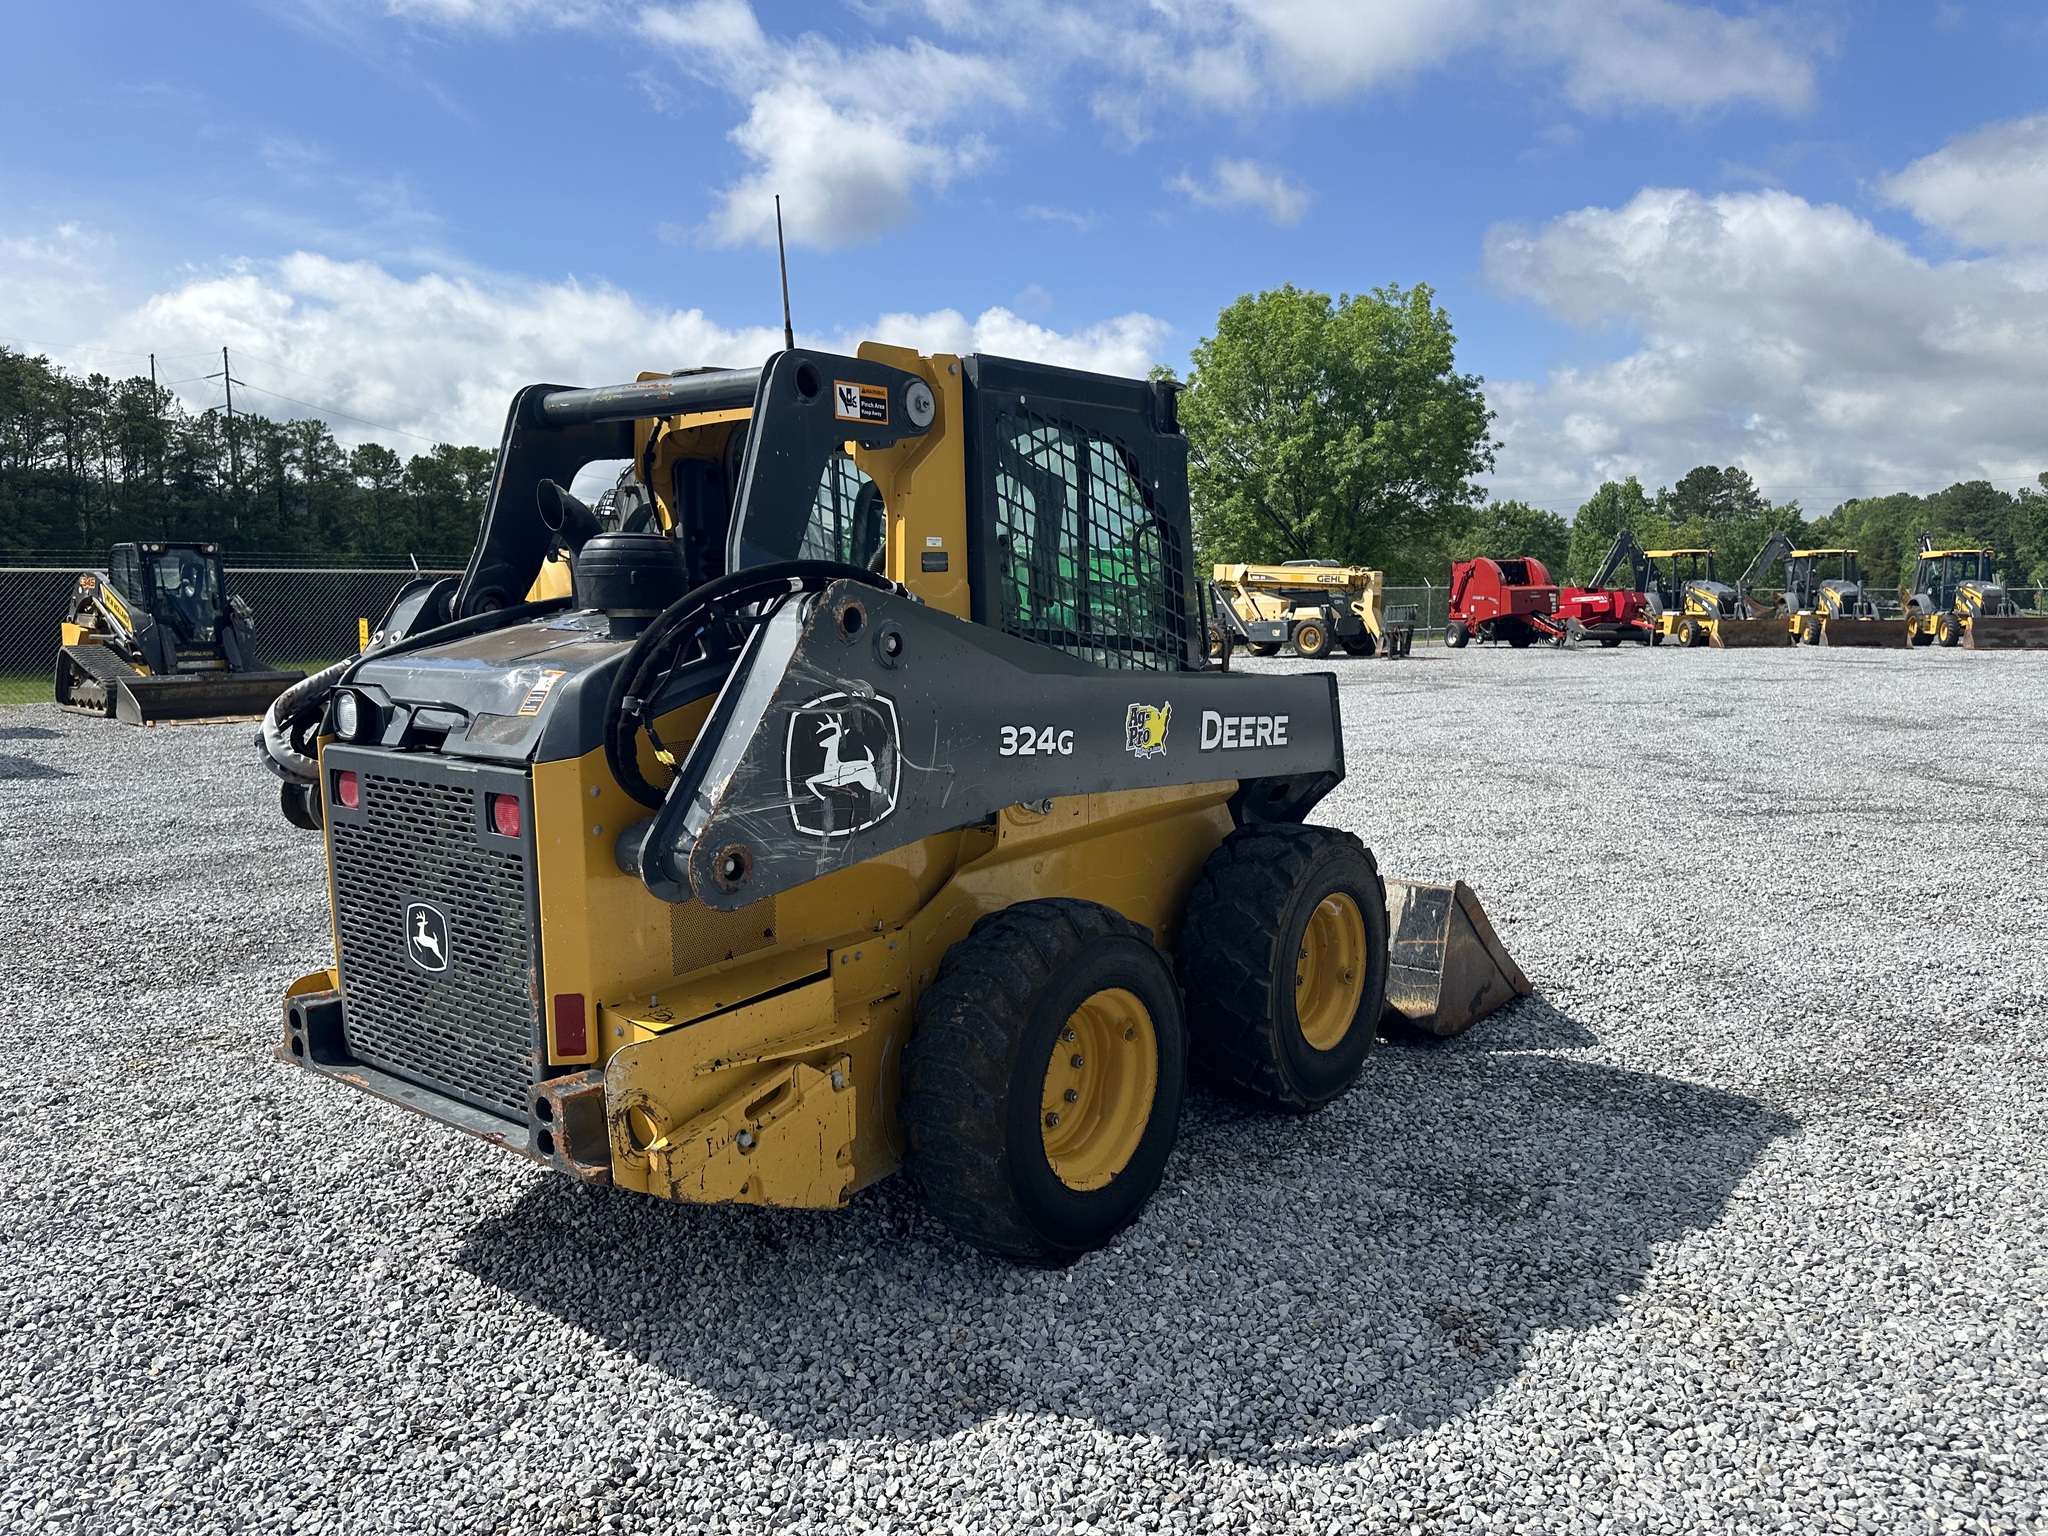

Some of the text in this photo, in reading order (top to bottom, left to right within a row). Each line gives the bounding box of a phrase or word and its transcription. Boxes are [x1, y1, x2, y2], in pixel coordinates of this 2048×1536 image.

[861, 401, 874, 409] Pinch
[1317, 575, 1344, 583] GEHL
[999, 725, 1075, 756] 324G
[1128, 726, 1151, 748] Pro
[1200, 710, 1290, 750] DEERE
